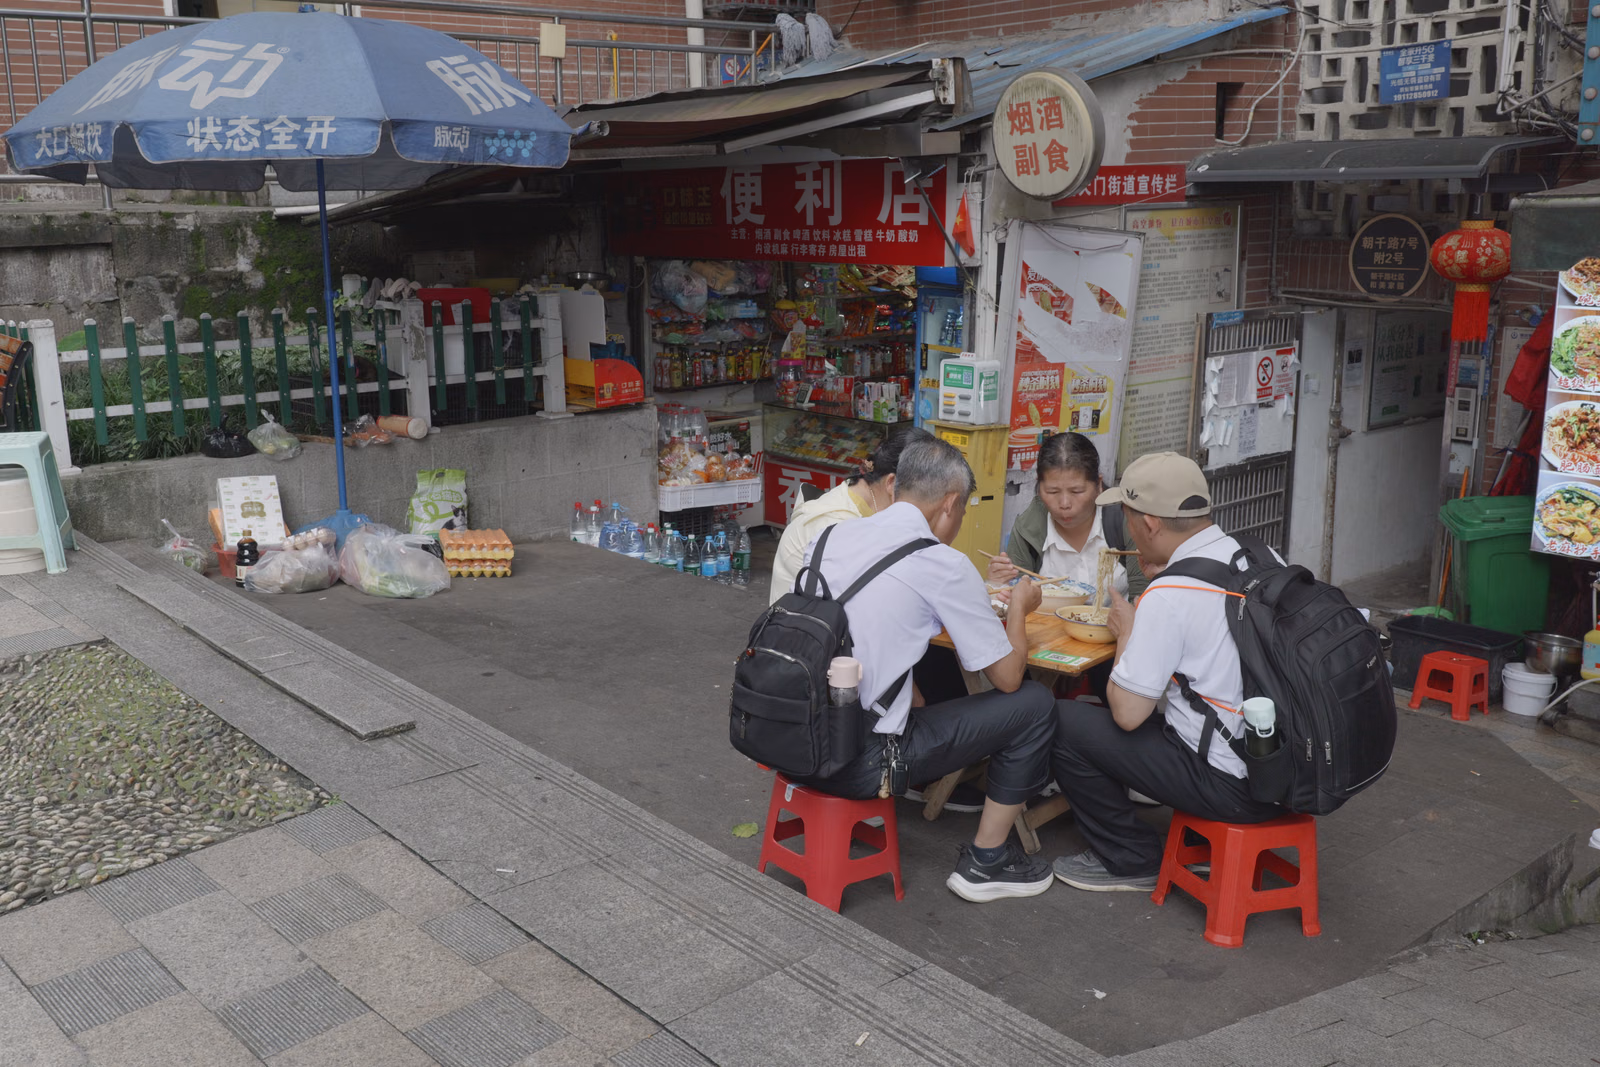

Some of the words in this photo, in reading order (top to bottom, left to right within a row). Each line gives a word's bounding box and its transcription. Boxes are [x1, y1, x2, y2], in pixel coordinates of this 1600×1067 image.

[426, 55, 531, 115] 脉
[1008, 96, 1064, 136] 烟酒
[187, 115, 337, 153] 状态全开
[434, 125, 470, 153] 脉动
[1013, 138, 1069, 176] 副食
[663, 187, 712, 207] 口味王
[720, 159, 934, 226] 便利店
[1078, 174, 1178, 197] 门街道宣传栏
[755, 229, 772, 241] 烟酒
[773, 229, 790, 241] 副食
[793, 229, 810, 241] 啤酒
[812, 229, 831, 242] 饮料
[833, 229, 852, 242] 冰糕
[854, 229, 873, 243] 雪糕
[876, 229, 896, 243] 牛奶
[898, 229, 919, 243] 酸奶
[1361, 236, 1419, 250] 朝千路7号
[791, 243, 827, 257] 行李寄存
[828, 244, 867, 258] 房屋出租
[1373, 252, 1404, 265] 附2号
[1017, 374, 1060, 392] 秒杀时刻
